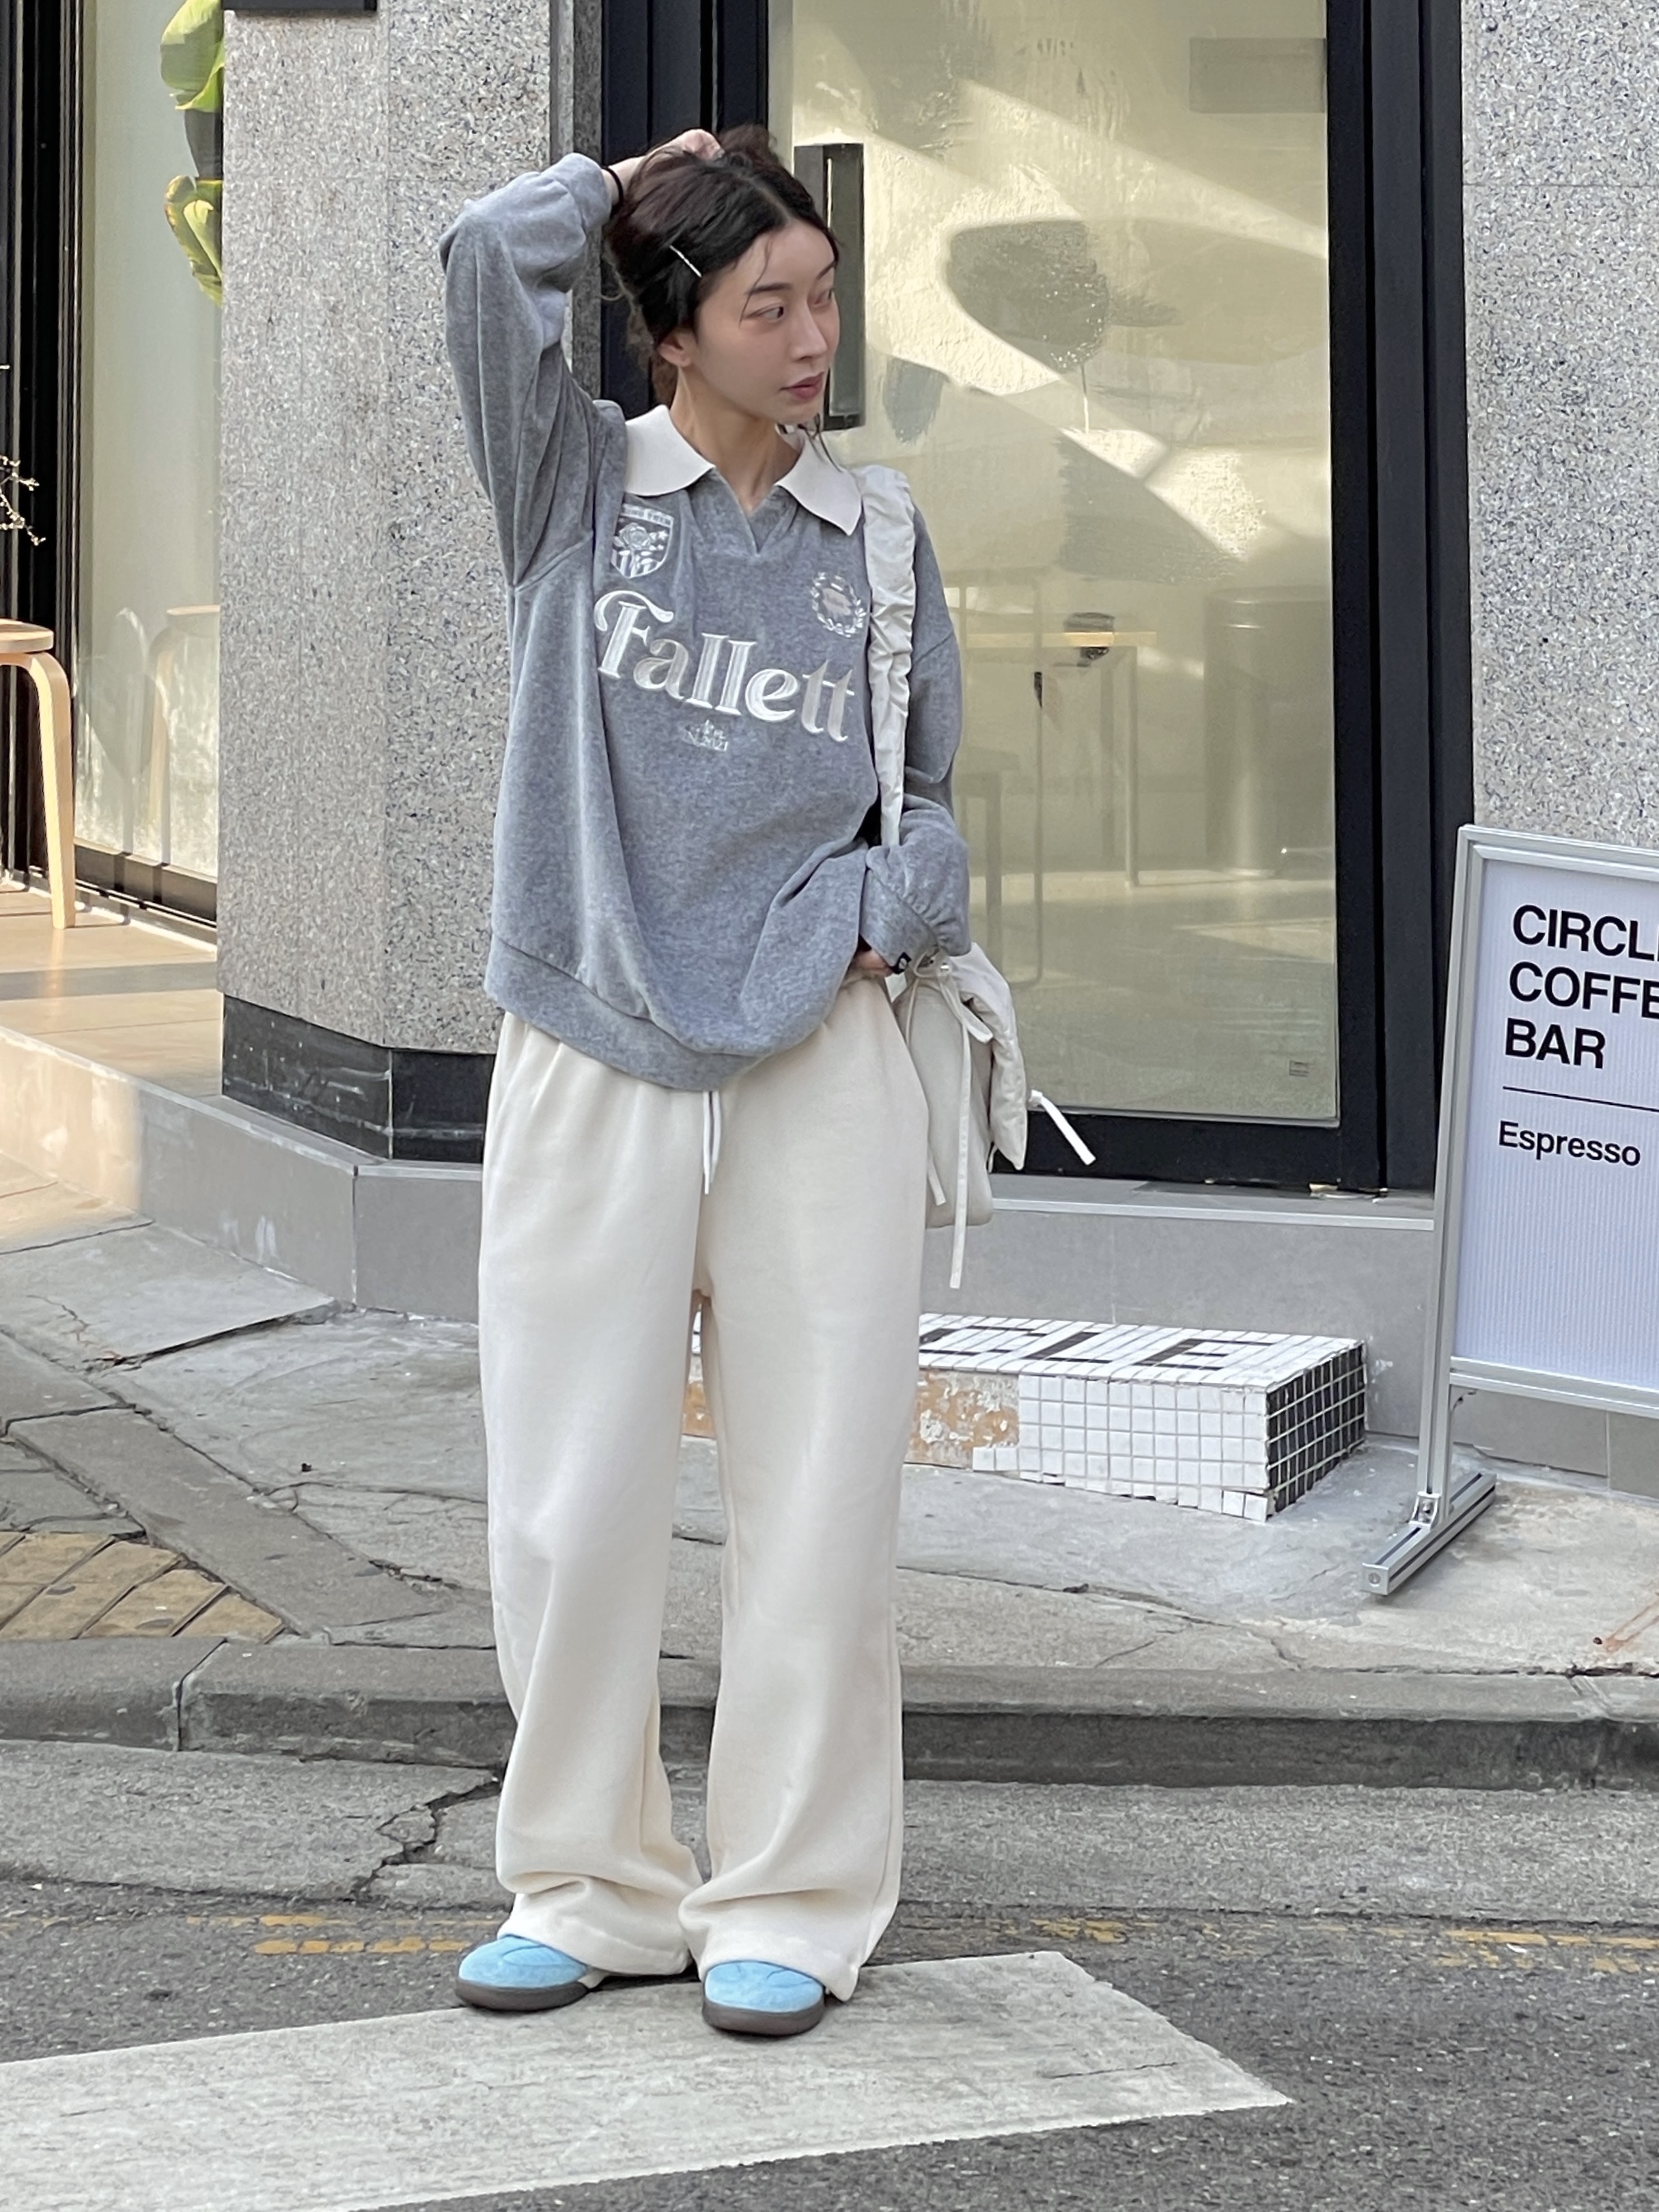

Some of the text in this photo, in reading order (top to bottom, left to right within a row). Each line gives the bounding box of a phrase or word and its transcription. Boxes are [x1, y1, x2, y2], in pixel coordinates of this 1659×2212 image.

[594, 590, 855, 742] Fallett
[1512, 904, 1659, 963] CIRCL
[1505, 1018, 1606, 1069] BAR
[1498, 1120, 1641, 1166] Espresso
